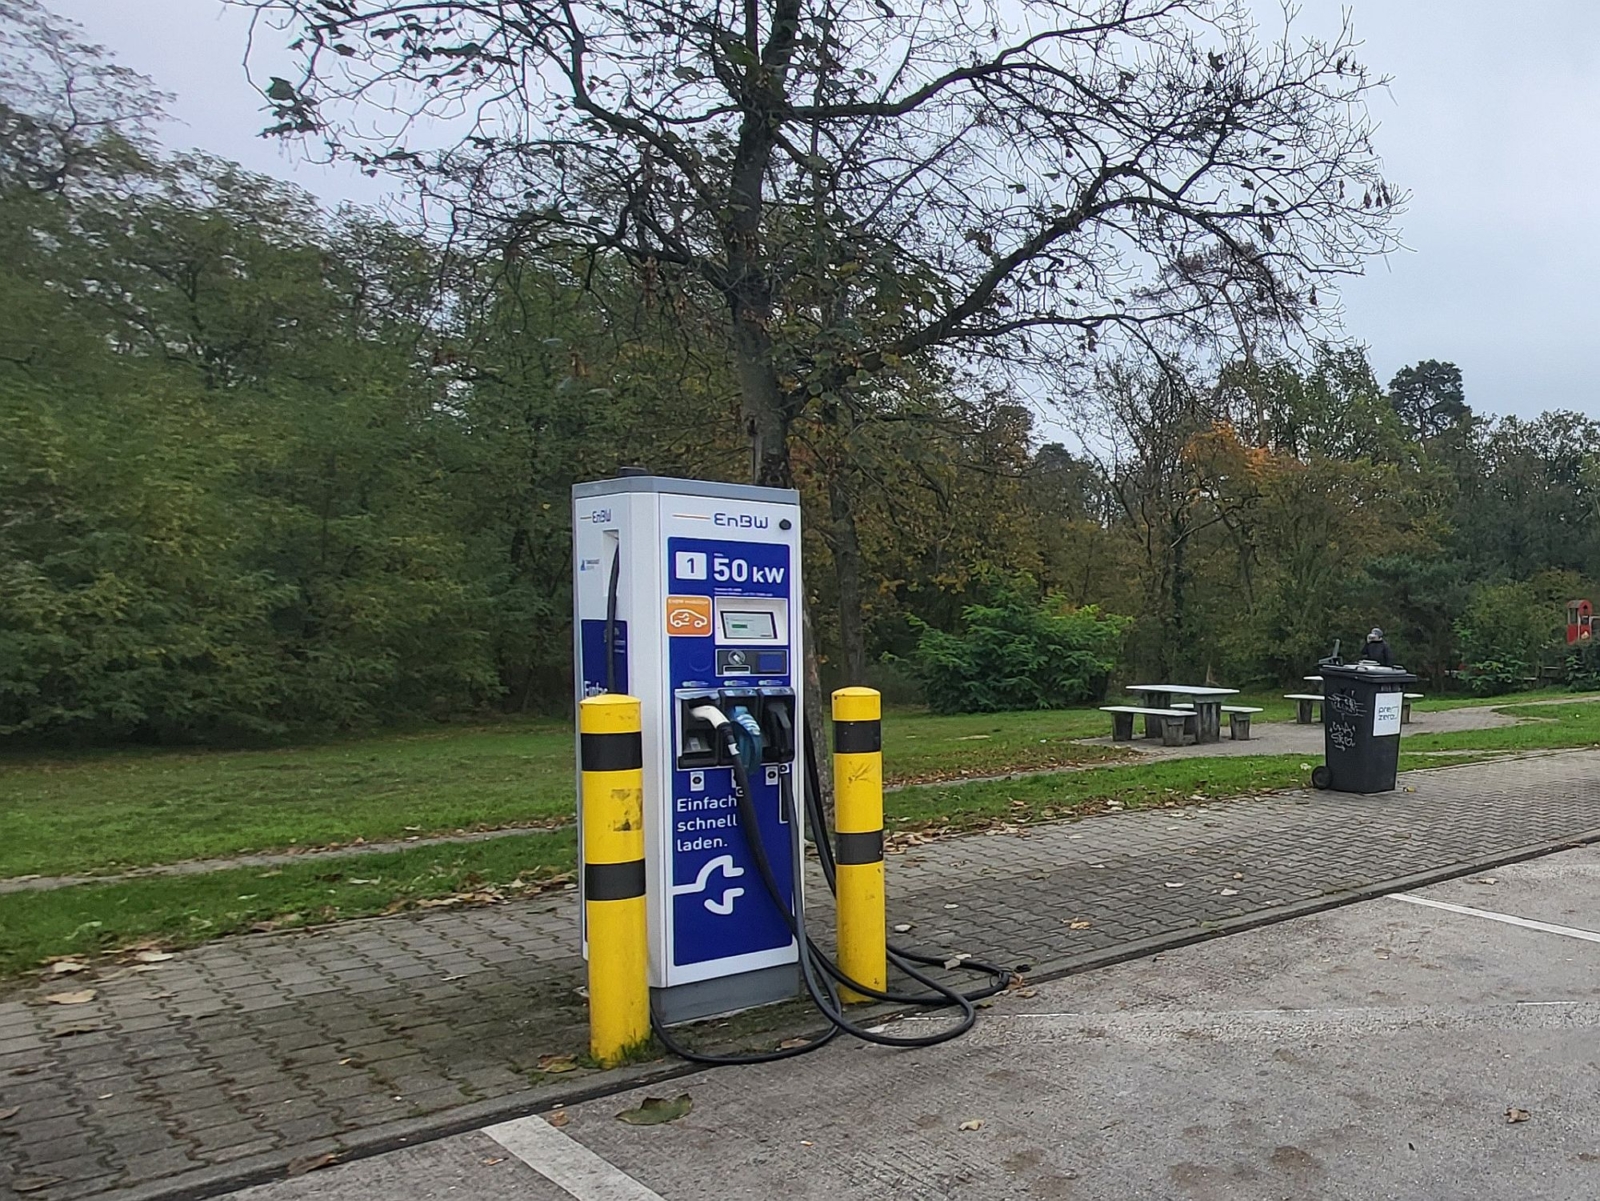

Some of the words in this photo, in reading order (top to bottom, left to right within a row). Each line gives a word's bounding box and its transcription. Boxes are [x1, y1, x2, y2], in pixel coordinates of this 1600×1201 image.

[592, 508, 612, 523] EnBW
[714, 512, 769, 530] EnBW
[686, 557, 696, 574] 1
[713, 556, 749, 582] 50
[752, 566, 785, 584] kW
[676, 794, 738, 812] Einfach
[676, 813, 738, 832] schnell
[676, 836, 728, 852] laden.
